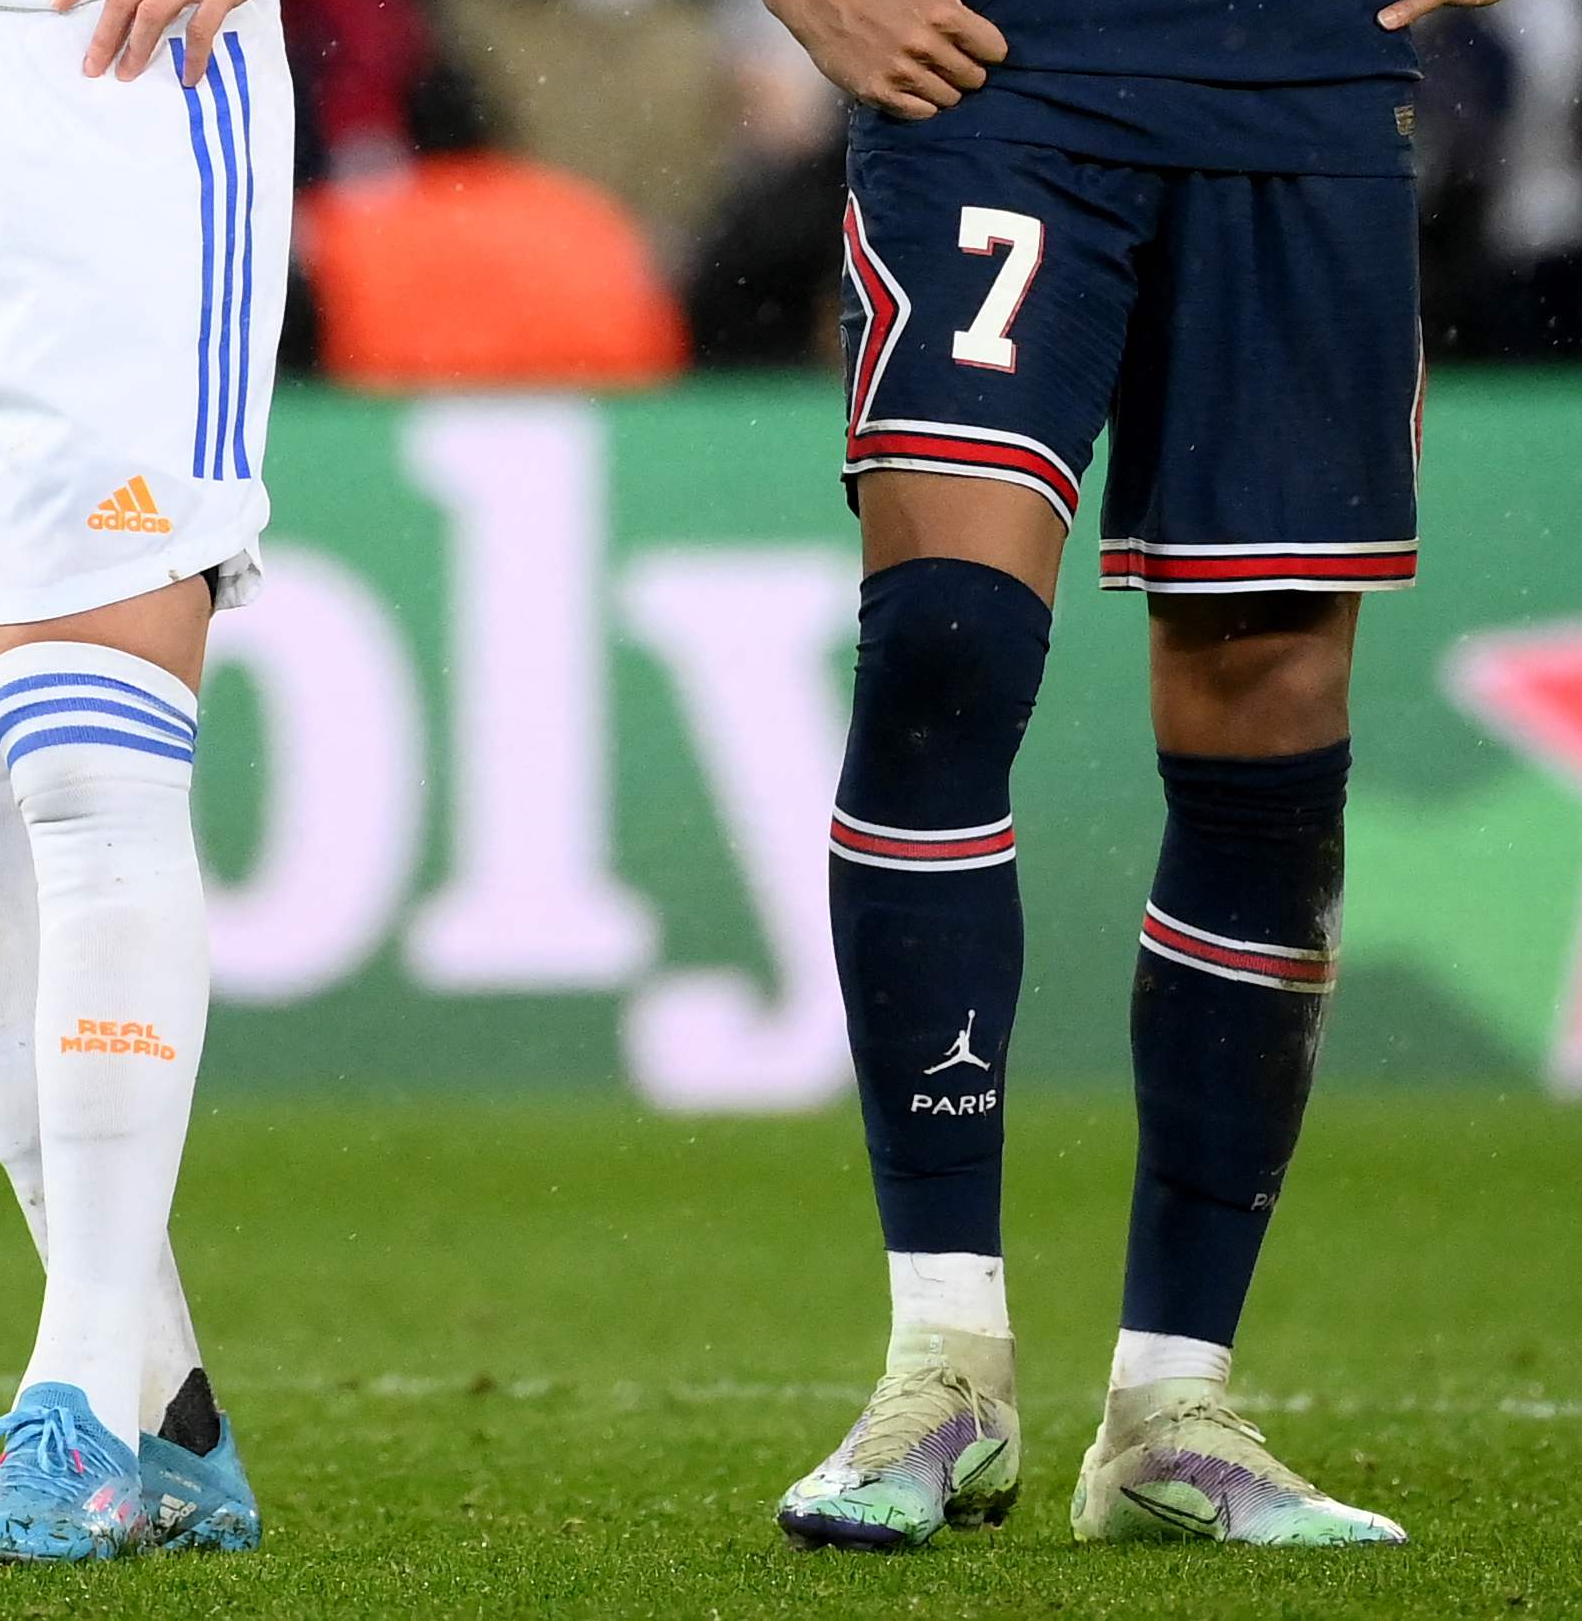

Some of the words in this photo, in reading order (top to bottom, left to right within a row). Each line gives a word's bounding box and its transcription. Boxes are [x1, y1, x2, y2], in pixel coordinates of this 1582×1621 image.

[951, 206, 1045, 374] 7
[87, 509, 172, 534] adidas
[78, 1019, 160, 1040] REAL
[60, 1035, 176, 1060] MADRID
[910, 1089, 997, 1116] PARIS
